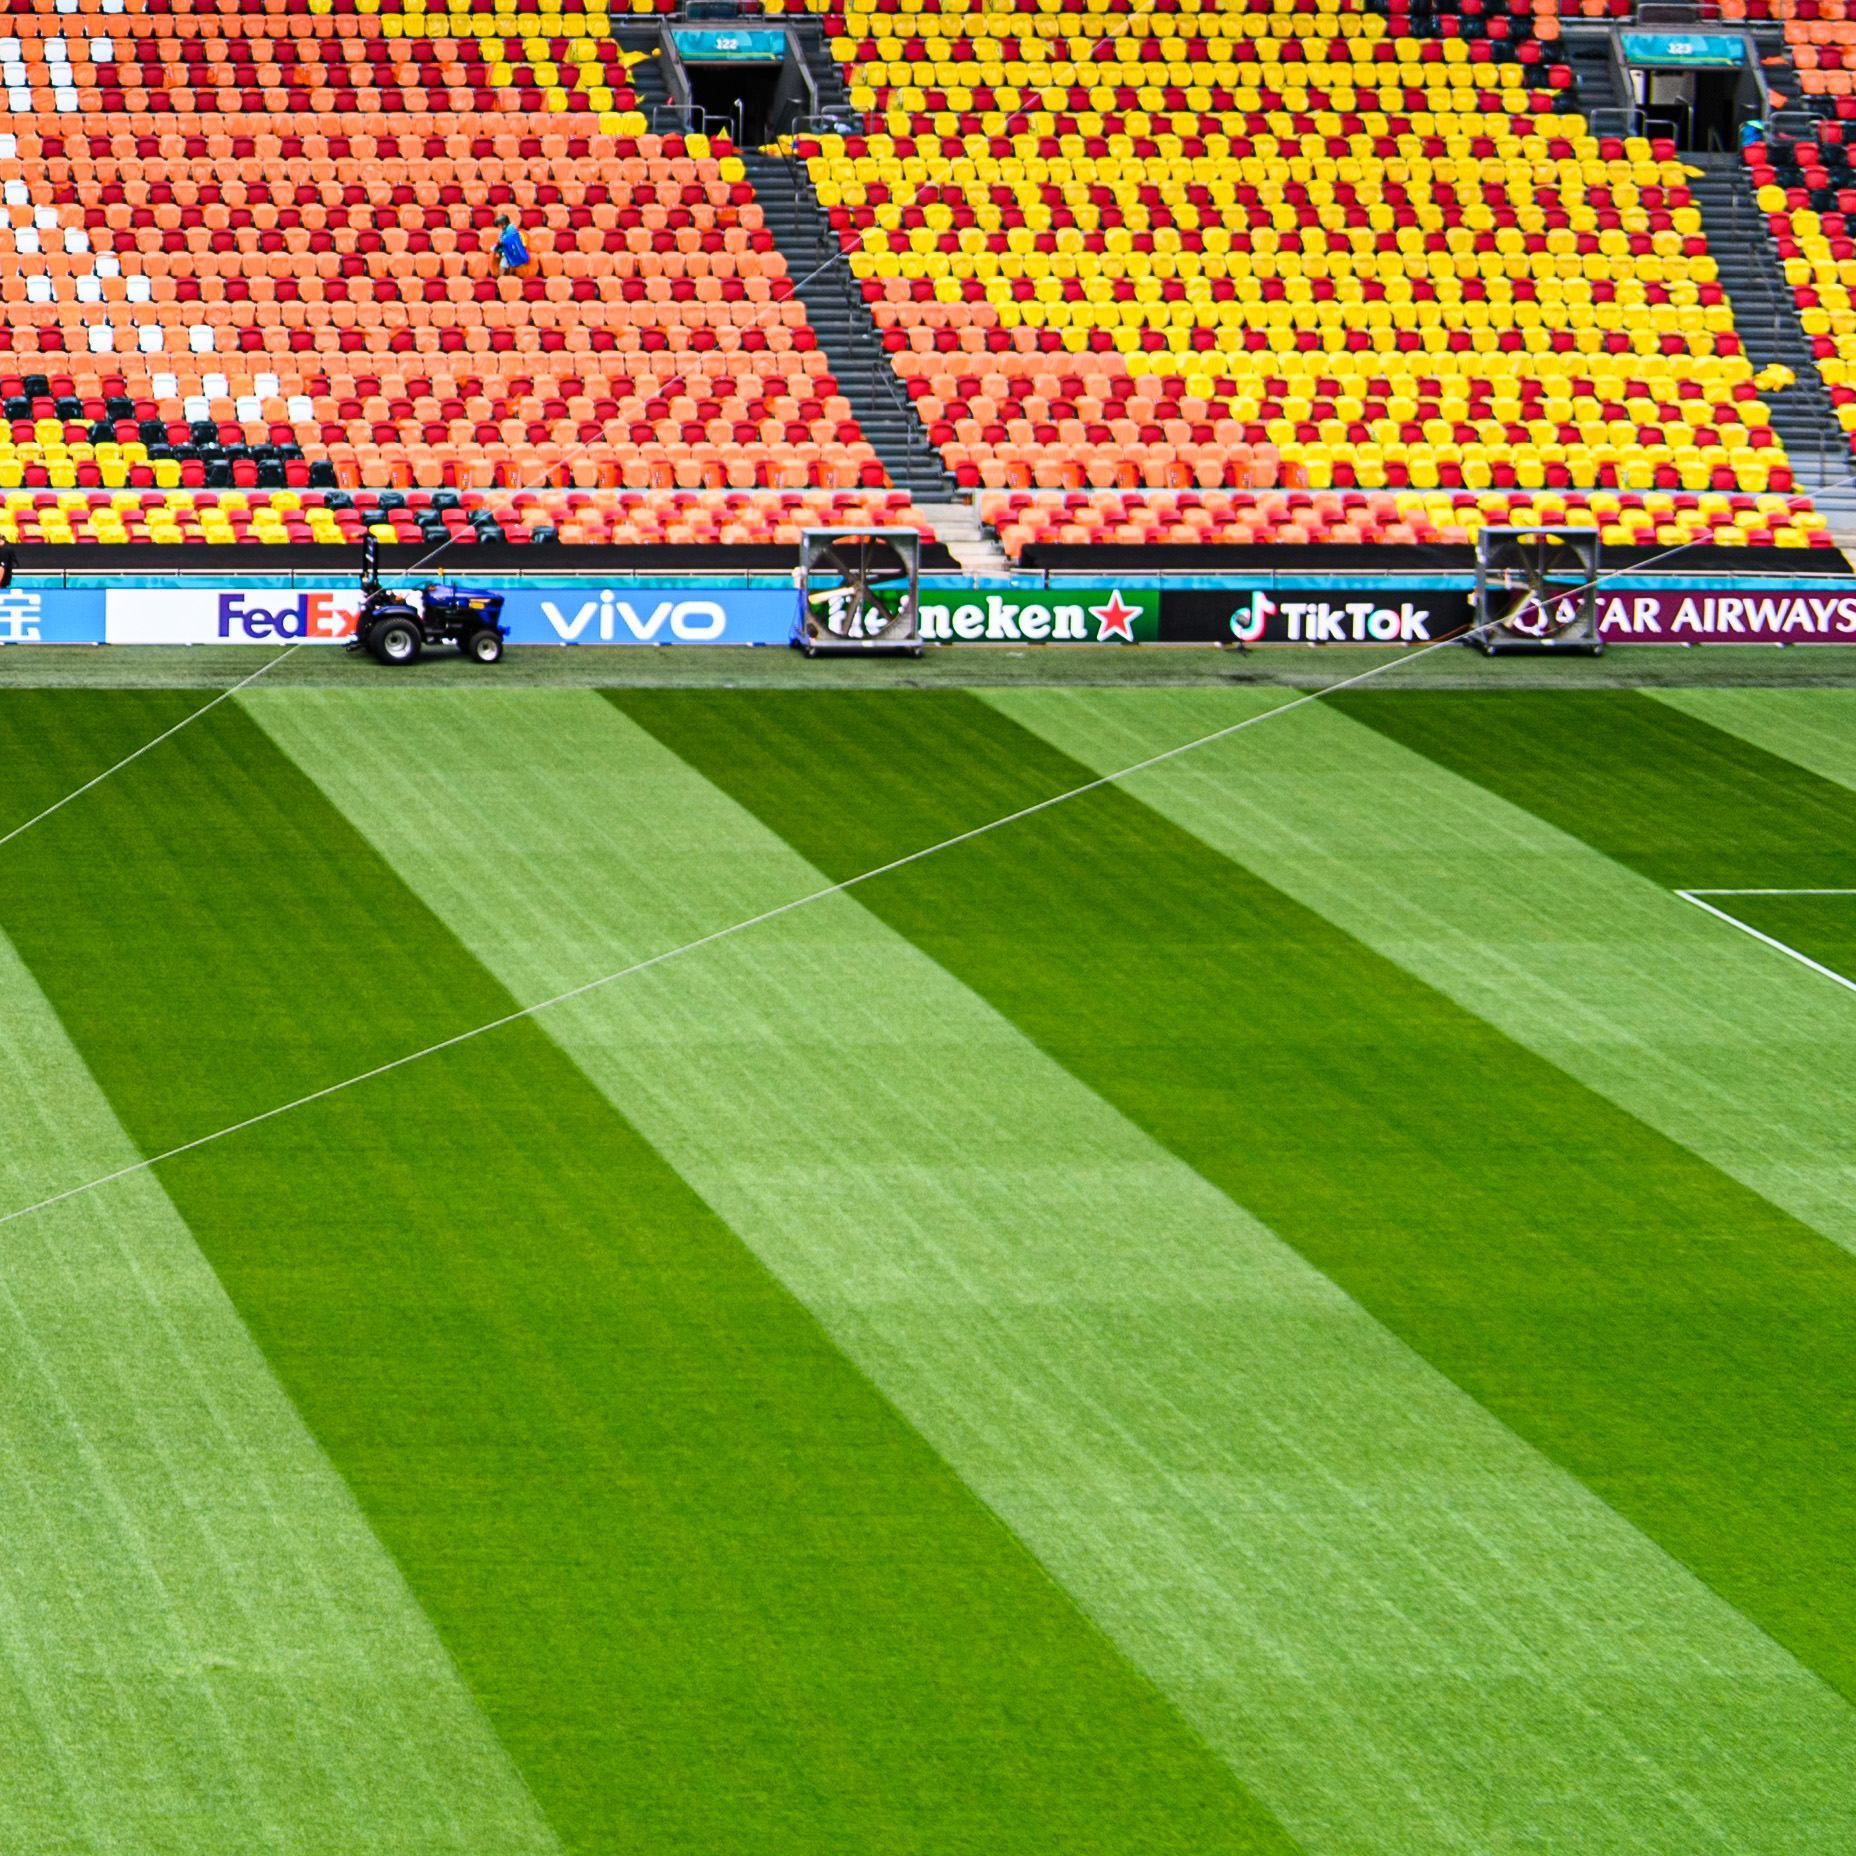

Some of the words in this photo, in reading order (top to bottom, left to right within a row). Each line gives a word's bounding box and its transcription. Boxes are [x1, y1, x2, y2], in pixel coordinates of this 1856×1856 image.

[716, 38, 737, 49] 122
[541, 590, 728, 640] vivo
[1281, 602, 1430, 641] TikTok
[1670, 597, 1856, 633] AIRWAYS
